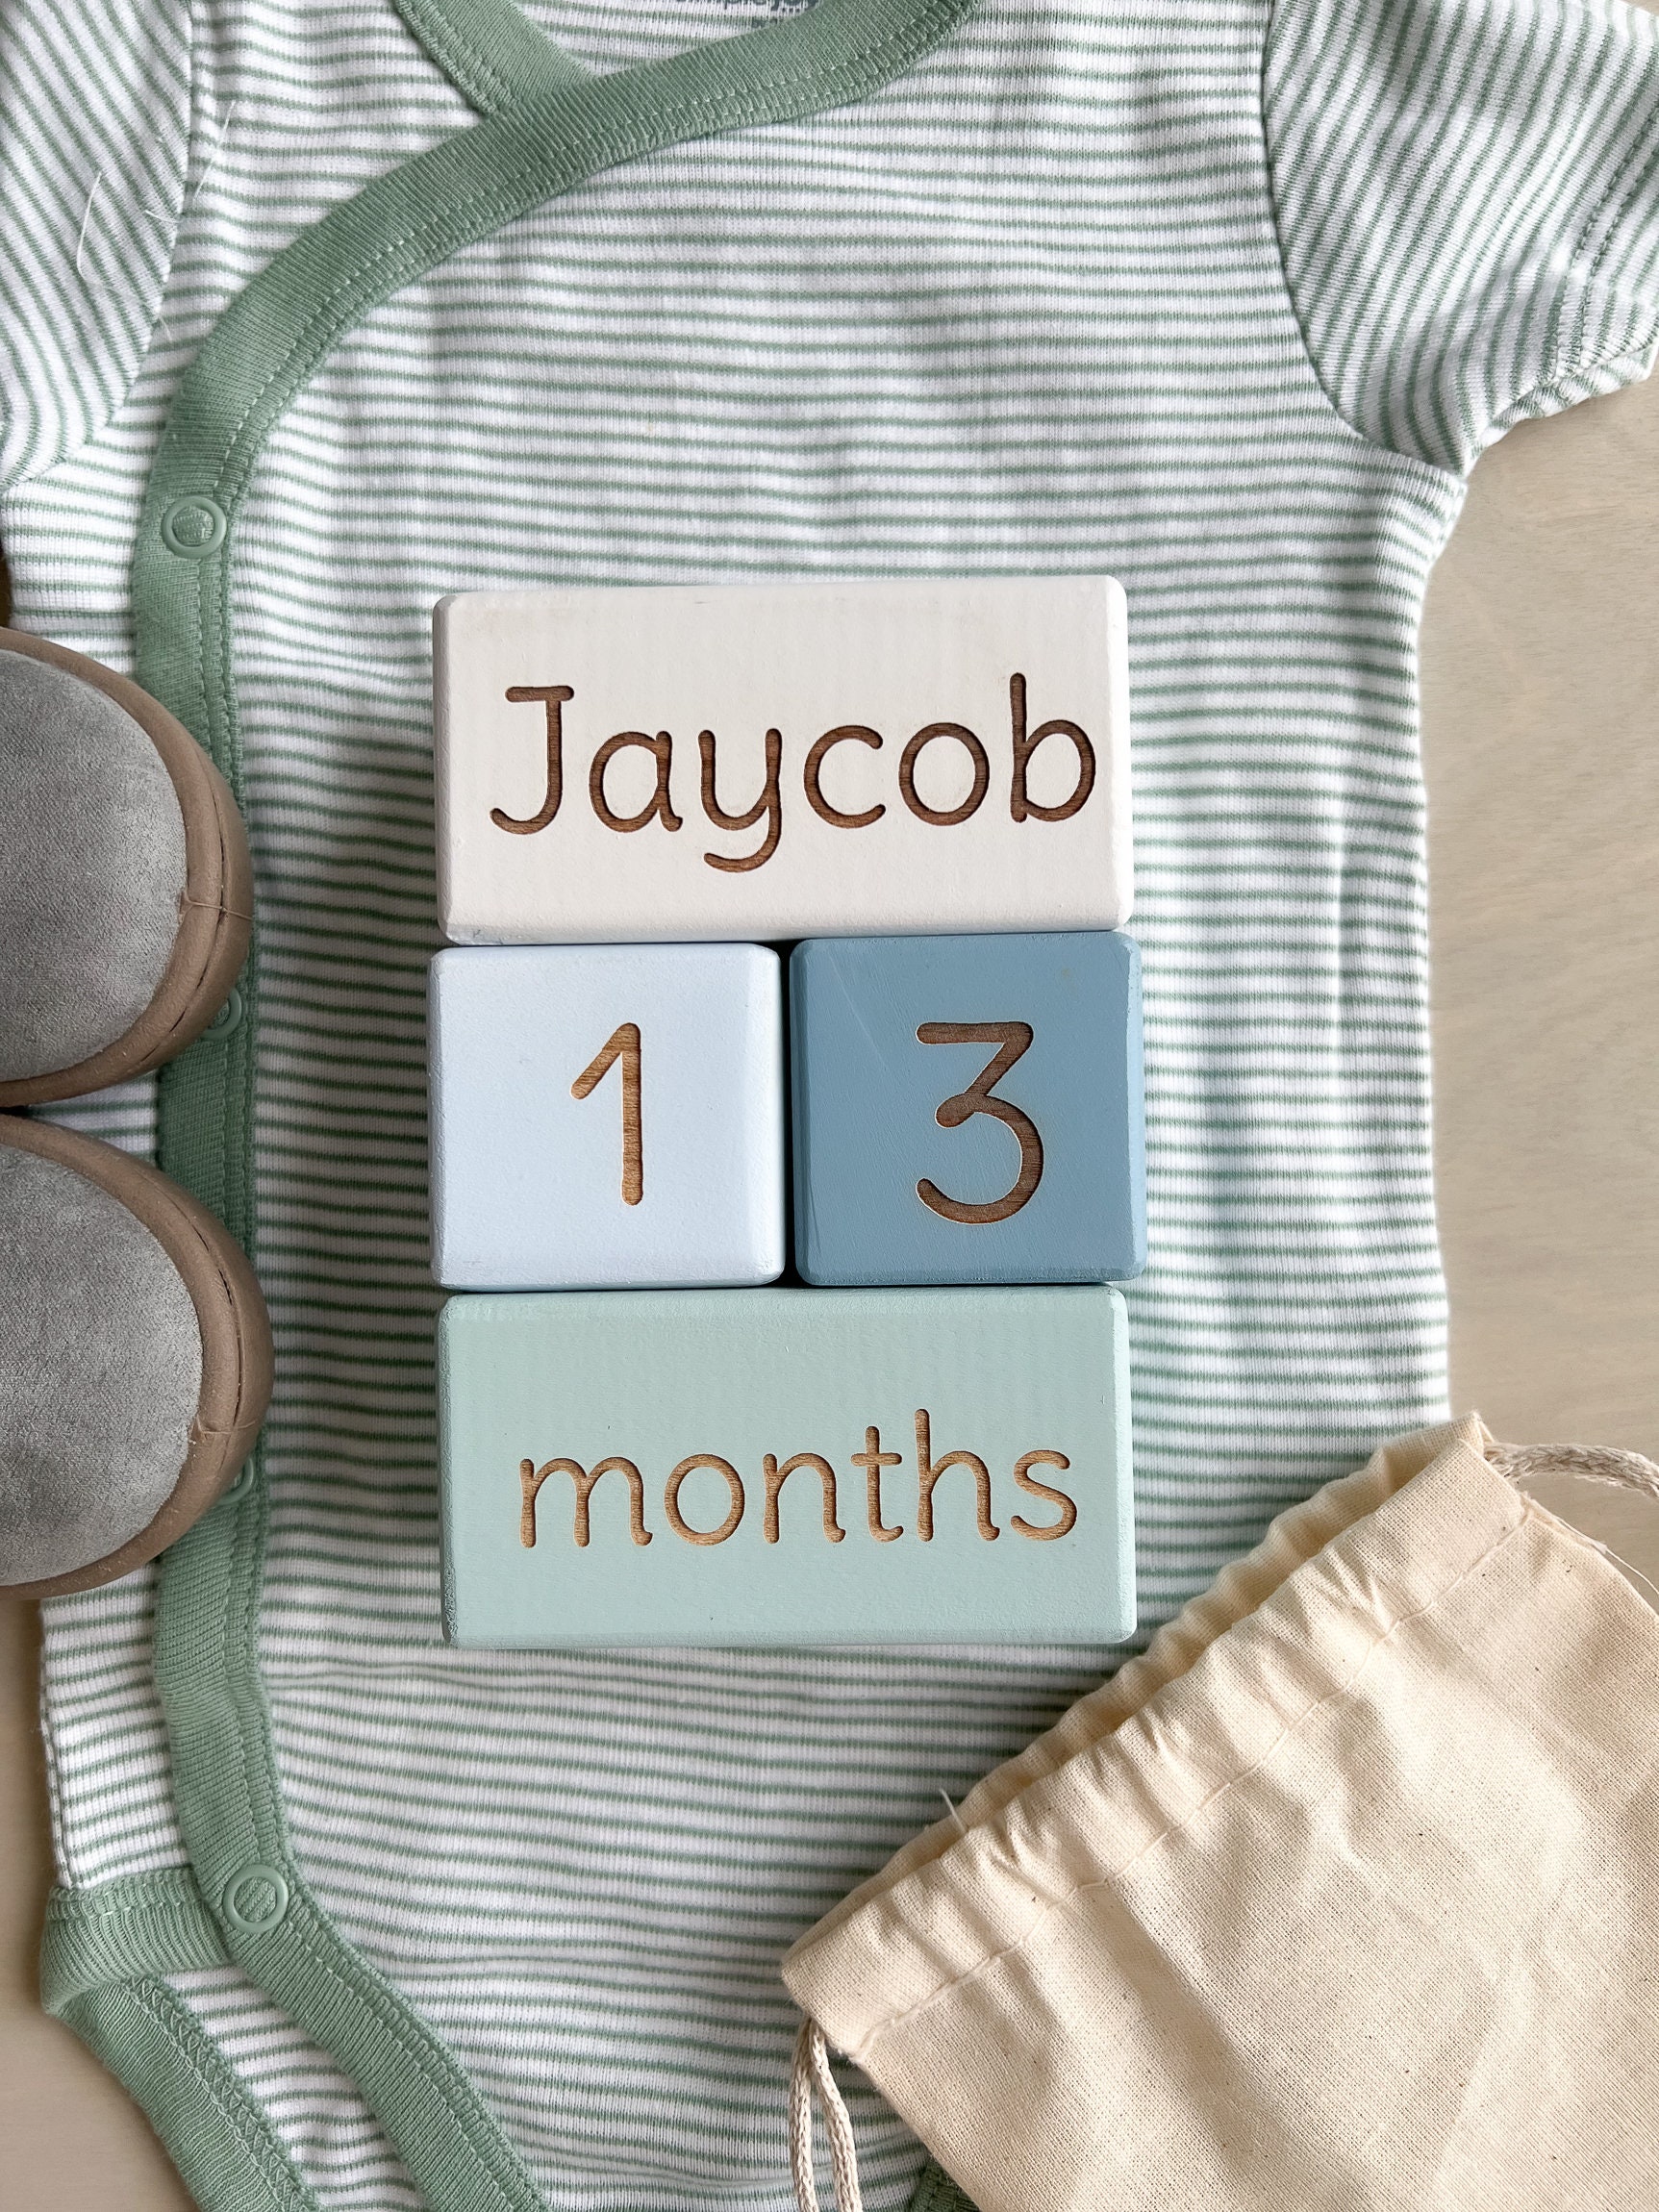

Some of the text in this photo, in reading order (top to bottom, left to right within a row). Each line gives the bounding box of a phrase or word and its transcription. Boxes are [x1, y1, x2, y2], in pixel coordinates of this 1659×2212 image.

[490, 672, 1096, 873] Jaycob
[570, 1021, 1044, 1225] 1 3
[519, 1409, 1078, 1548] months
